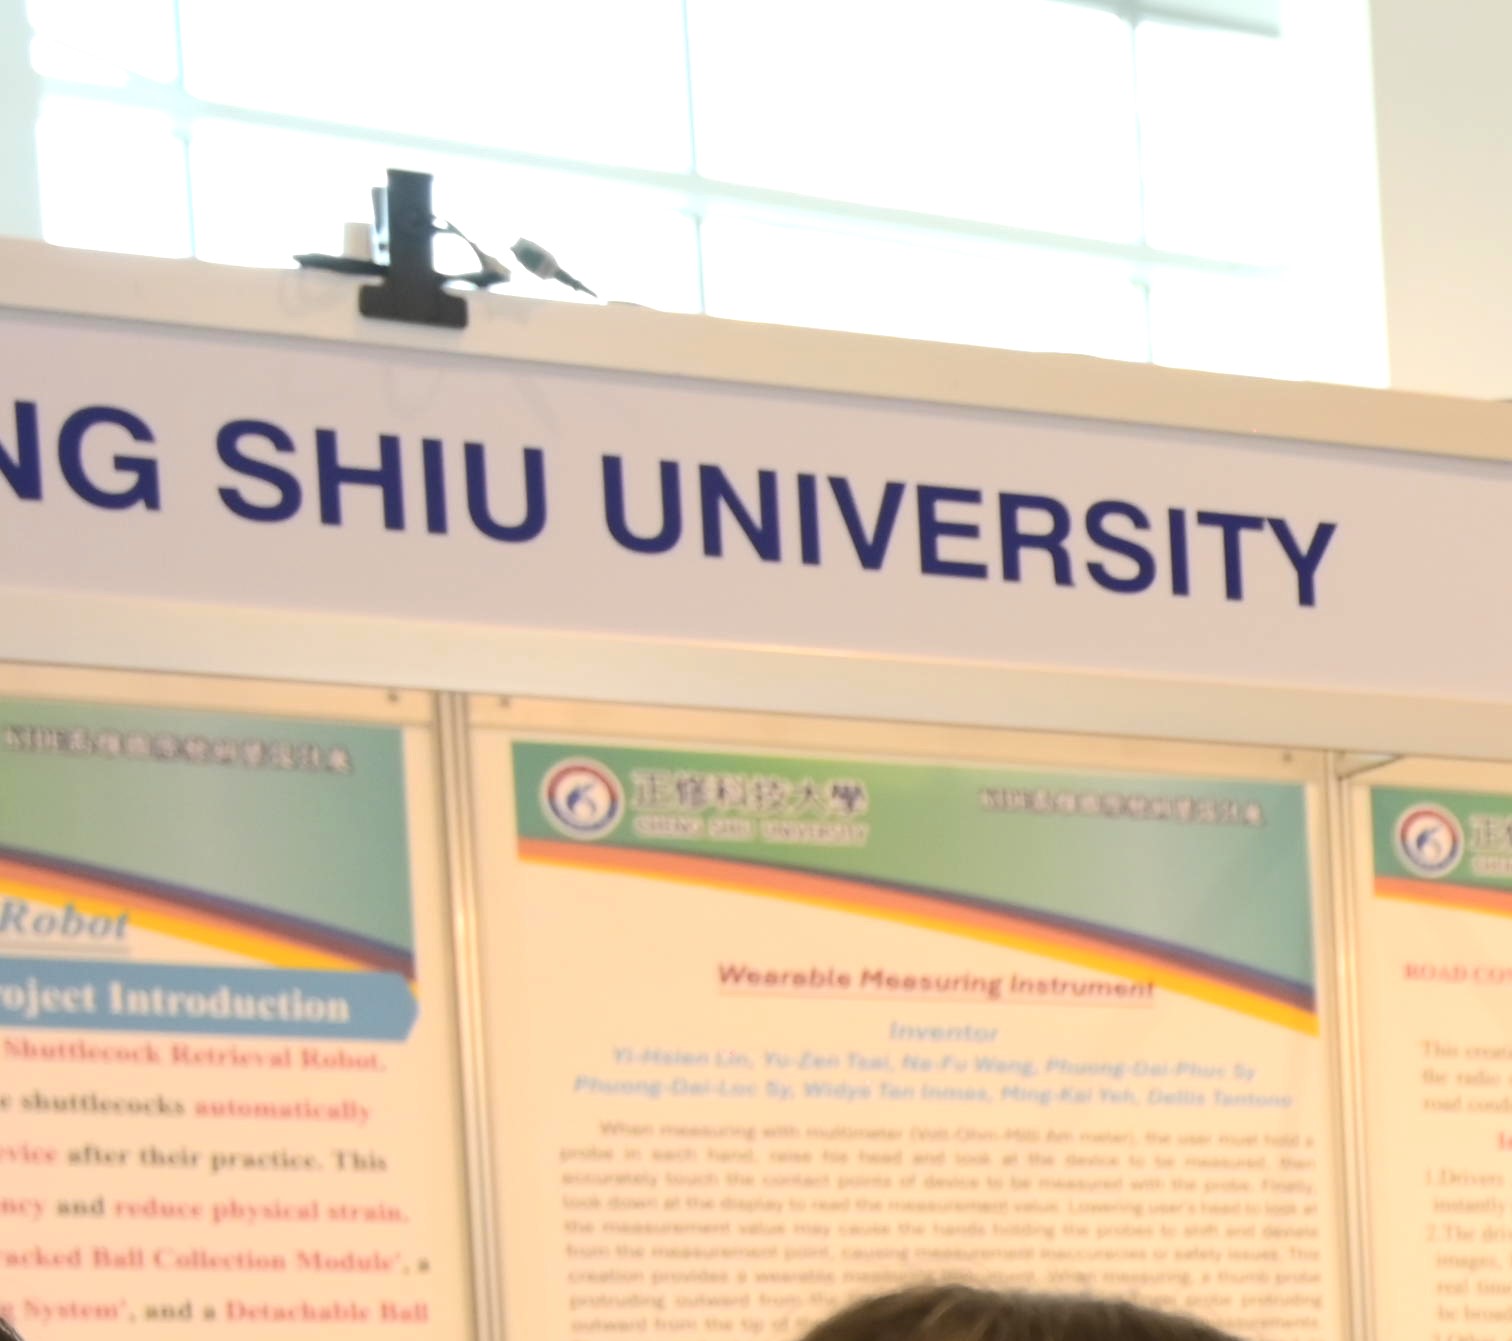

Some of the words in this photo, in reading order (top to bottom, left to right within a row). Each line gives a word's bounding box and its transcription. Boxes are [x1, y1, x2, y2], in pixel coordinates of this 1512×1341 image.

[215, 420, 547, 542] SHIU
[601, 455, 1337, 608] UNIVERSITY
[0, 897, 131, 940] Robot
[716, 962, 852, 989] Wearable
[1010, 971, 1156, 999] Instrument
[110, 979, 351, 1024] Introduction
[3, 1037, 162, 1068] Shuttlecock
[171, 1042, 292, 1071] Retrieval
[21, 1090, 185, 1117] shuttlecocks
[195, 1098, 372, 1126] automatically
[67, 1144, 129, 1167] after
[140, 1146, 200, 1168] their
[333, 1148, 388, 1173] This
[57, 1197, 105, 1218] and
[115, 1198, 203, 1220] reduce
[212, 1200, 320, 1226] physical
[92, 1248, 145, 1271] Ball
[153, 1248, 288, 1274] Collection
[144, 1301, 193, 1322] and
[225, 1301, 370, 1325] Detachable
[380, 1302, 431, 1325] Ball
